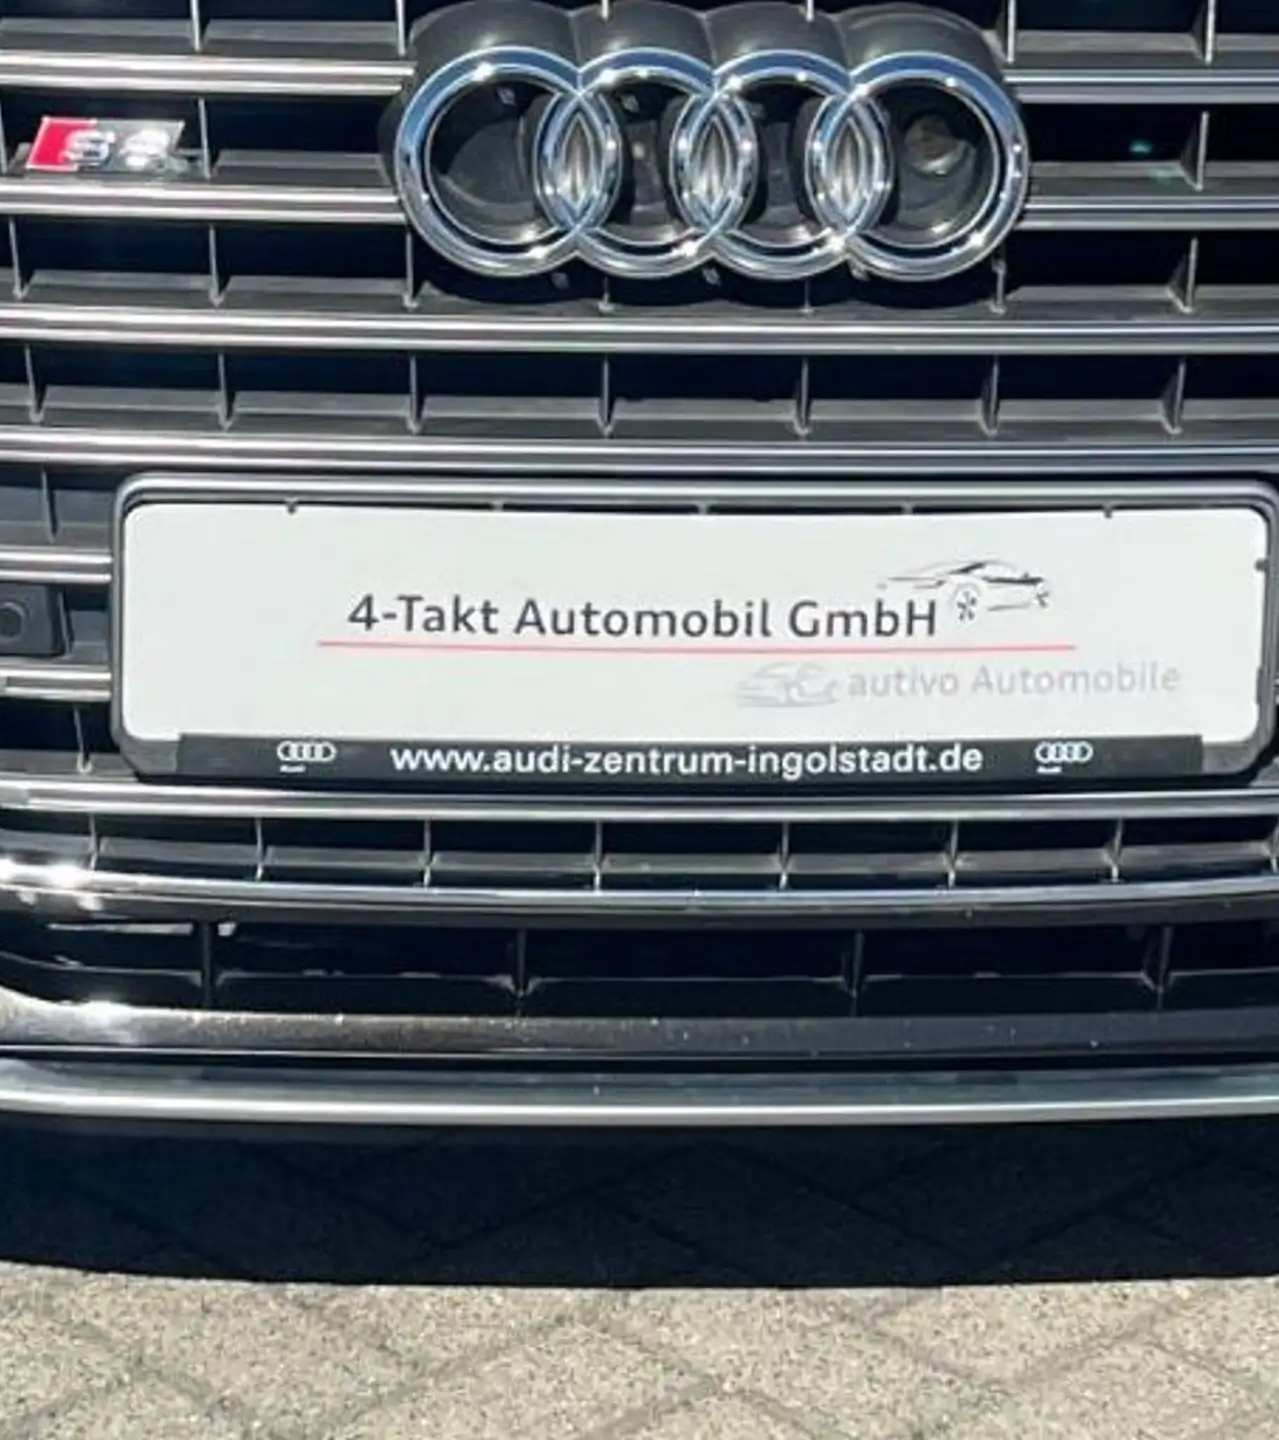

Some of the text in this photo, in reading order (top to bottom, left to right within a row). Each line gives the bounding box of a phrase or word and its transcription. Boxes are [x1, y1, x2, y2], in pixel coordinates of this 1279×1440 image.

[347, 593, 937, 638] 4-Takt Automobil GmbH
[847, 663, 1182, 698] autivo Automobile
[389, 743, 984, 781] www.audi-zentrum-ingolstadt.de
